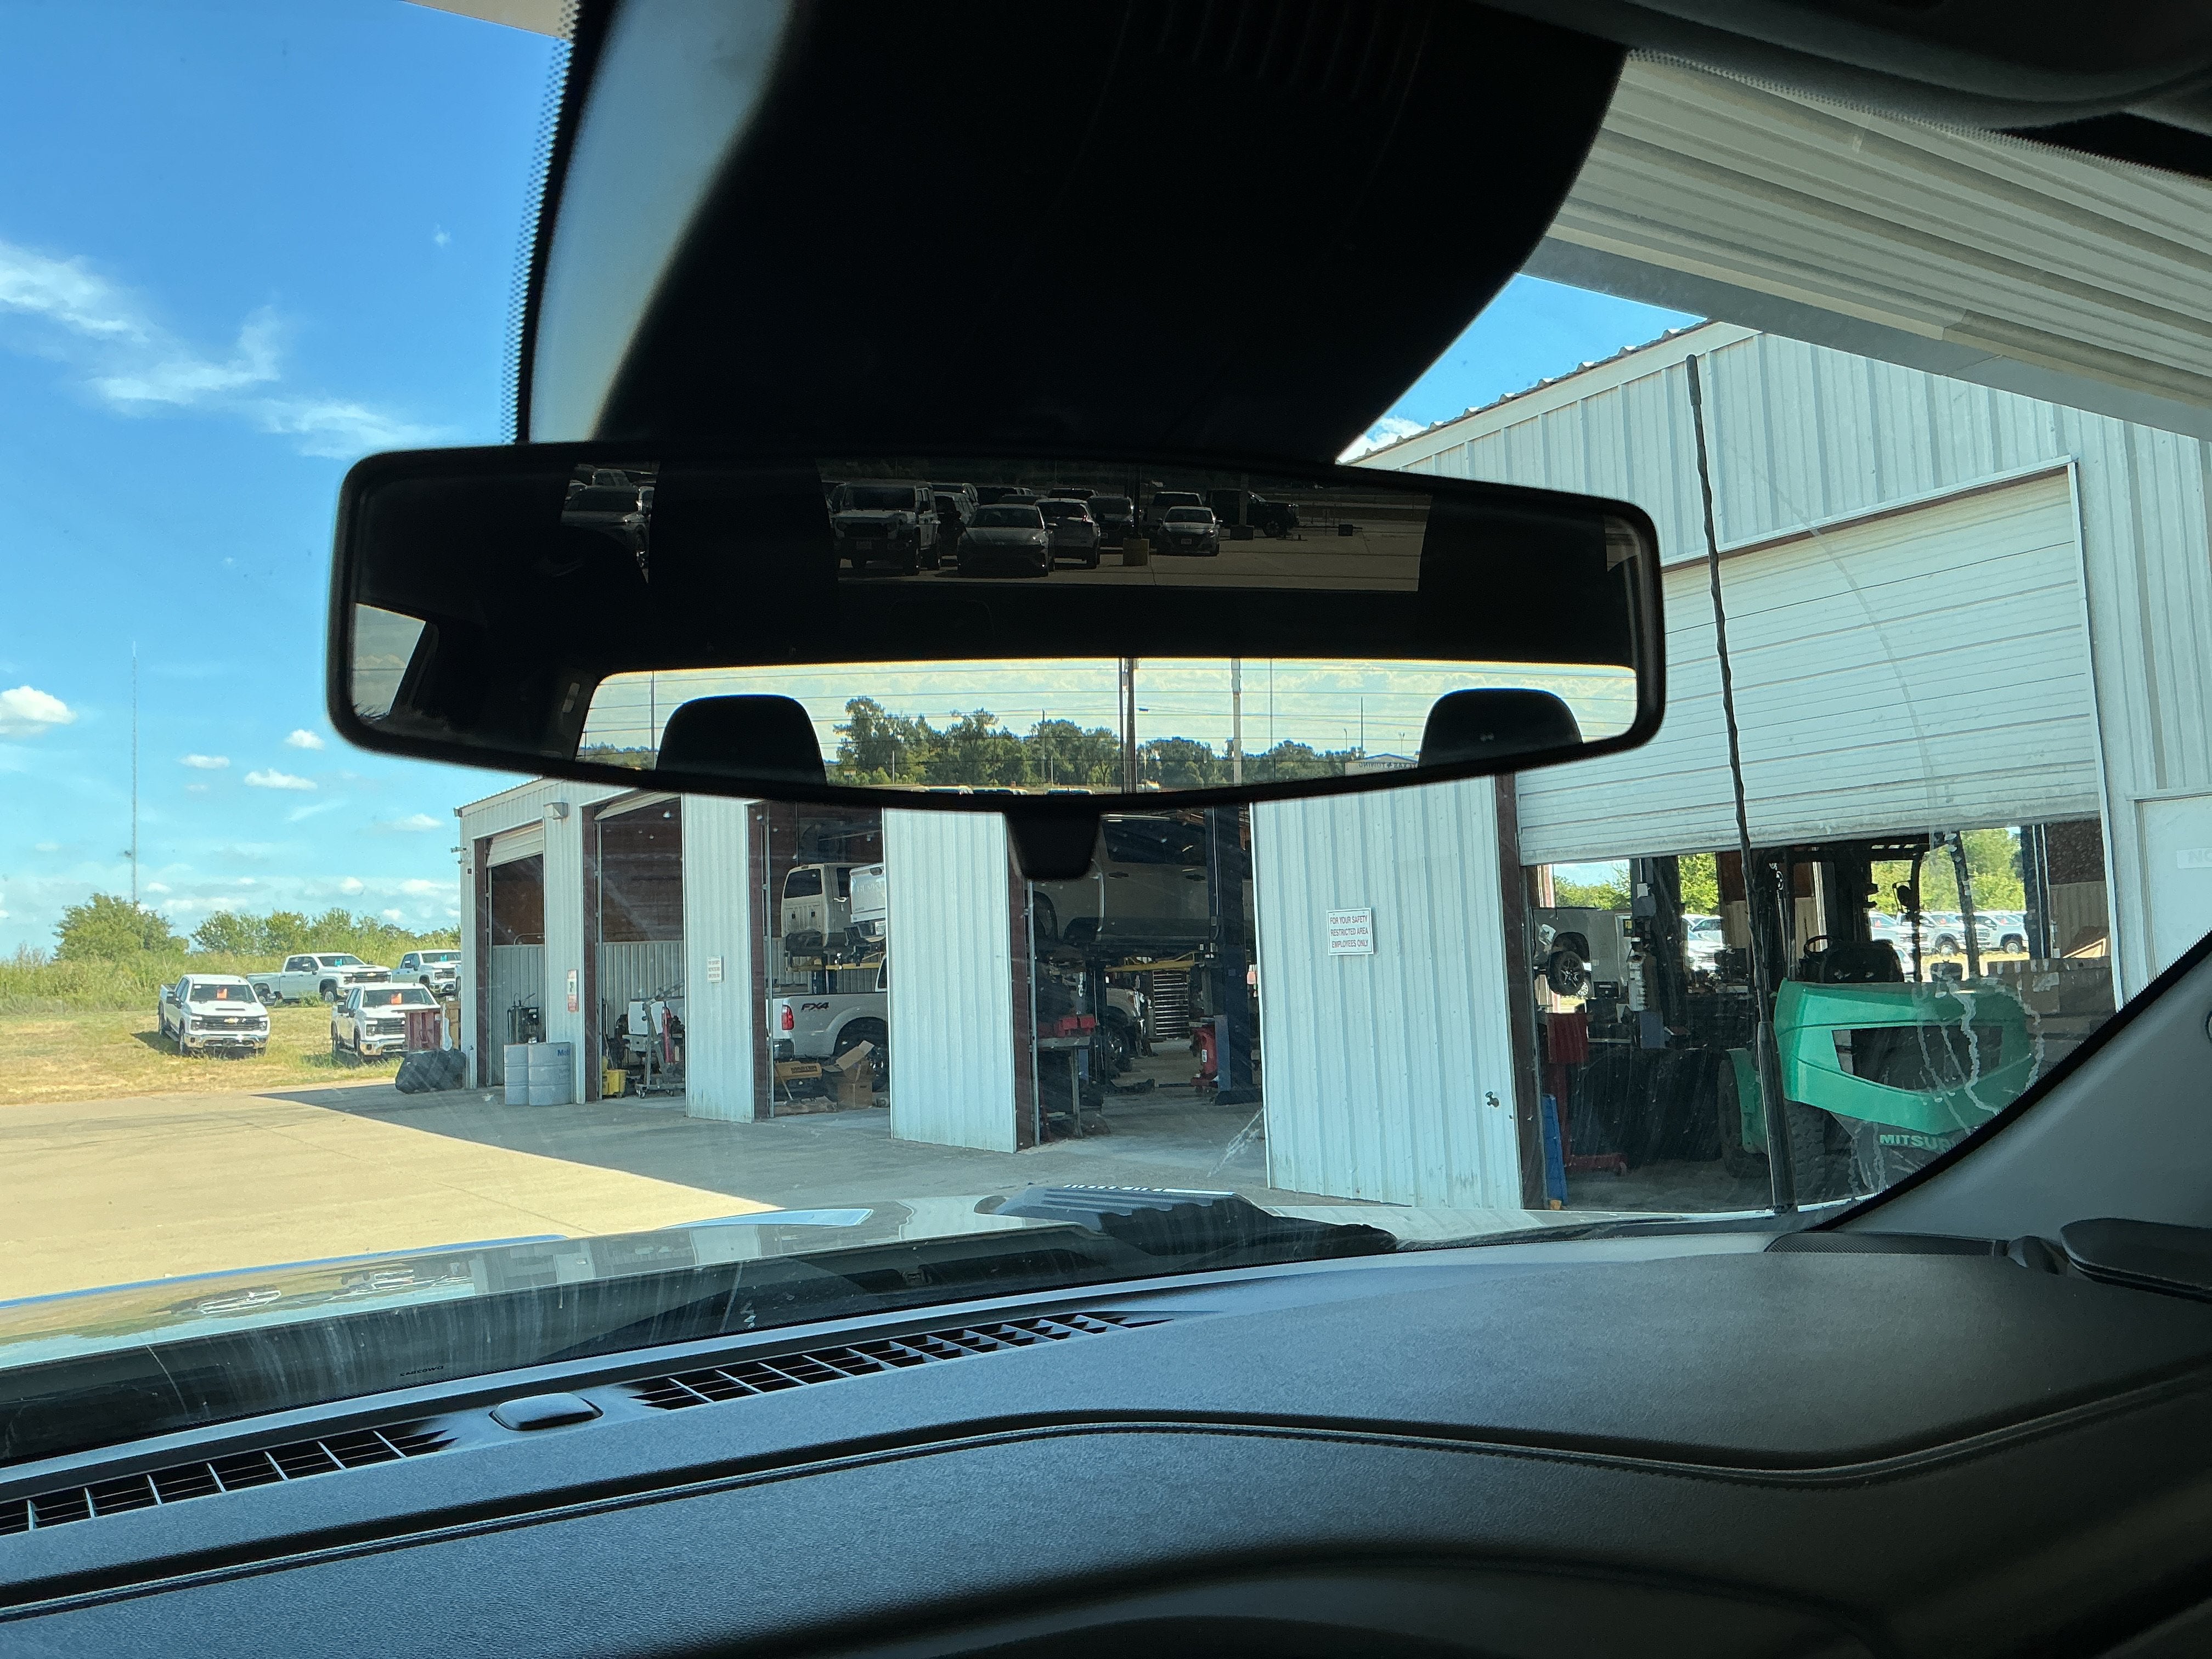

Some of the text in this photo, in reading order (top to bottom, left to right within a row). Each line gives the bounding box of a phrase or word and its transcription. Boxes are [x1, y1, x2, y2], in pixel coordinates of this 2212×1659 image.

[1340, 916, 1351, 924] YOUR
[1352, 915, 1367, 923] SAFETY
[1330, 928, 1356, 936] RESTRICTED
[1331, 939, 1368, 948] EMPLOYEES ONLY
[801, 1002, 829, 1011] FX4
